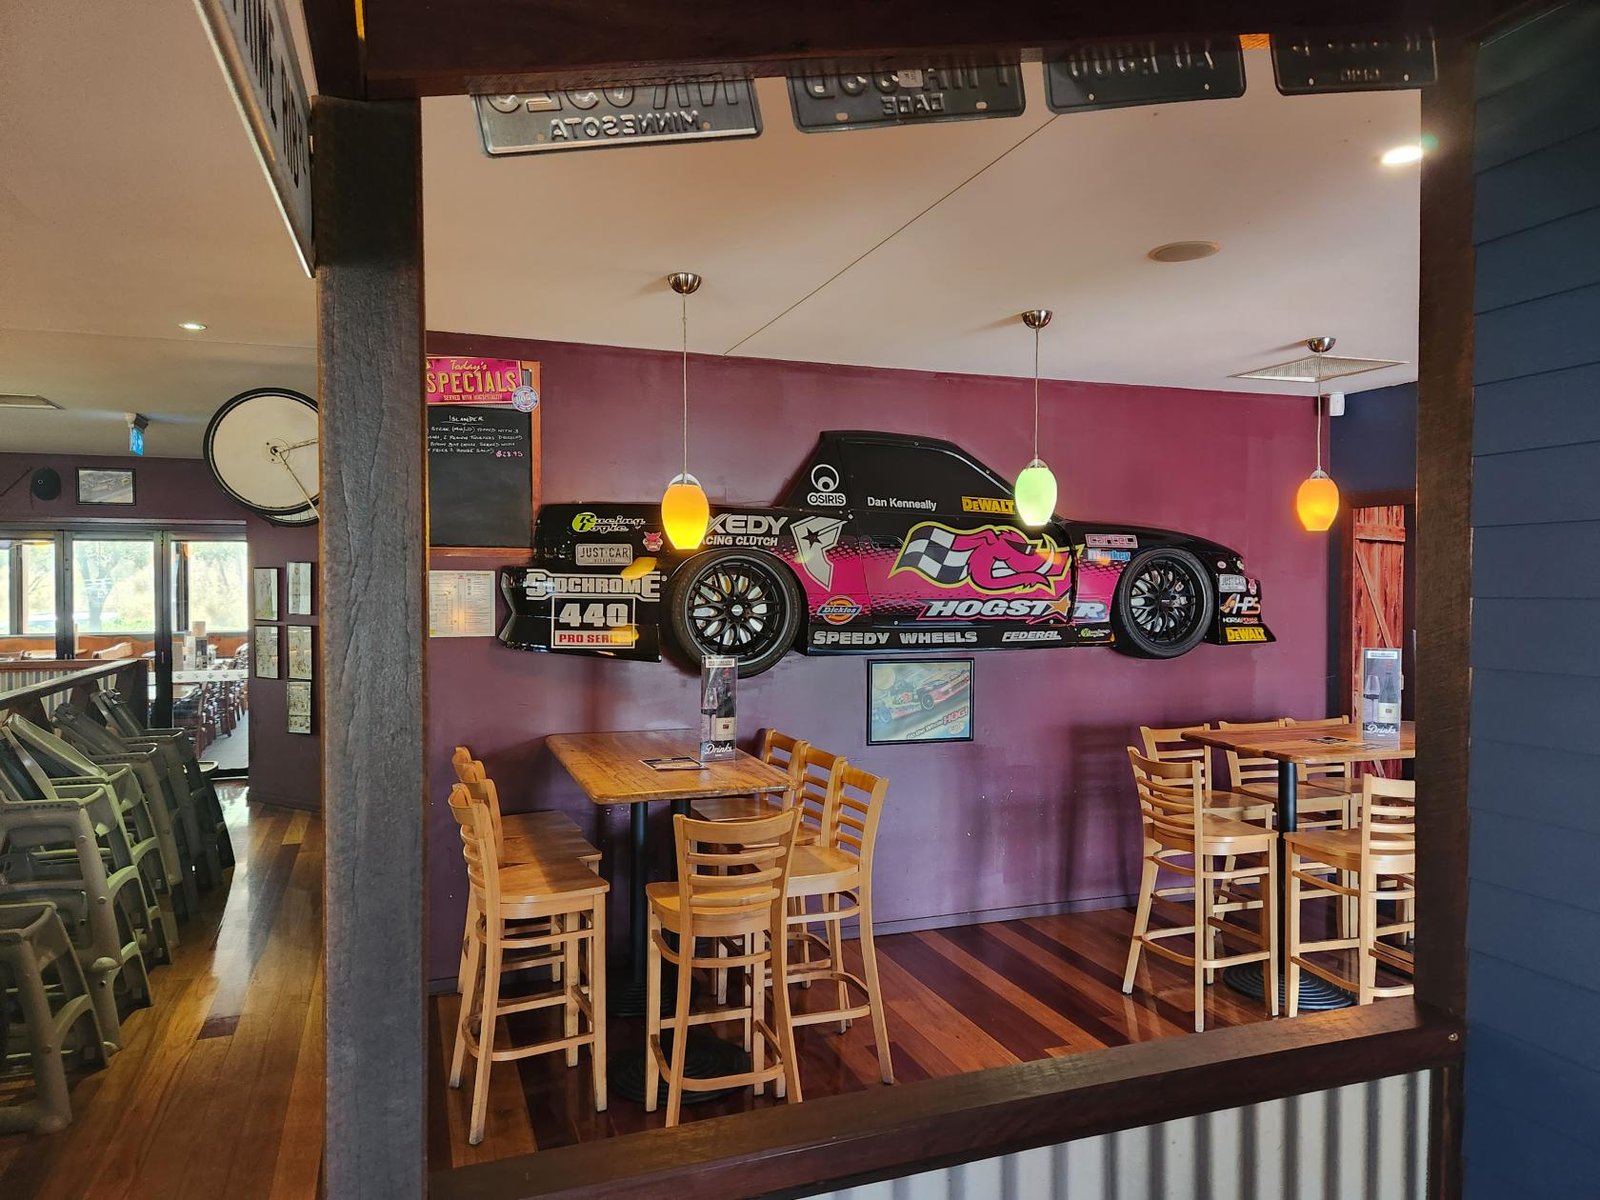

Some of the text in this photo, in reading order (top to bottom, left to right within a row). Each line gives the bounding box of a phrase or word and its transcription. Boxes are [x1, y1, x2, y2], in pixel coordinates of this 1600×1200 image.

[449, 360, 487, 374] Today's
[427, 370, 516, 393] SPECIALS
[807, 493, 846, 506] OSIRIS
[867, 496, 937, 511] Dan Kenneally
[705, 513, 789, 535] XEDY
[735, 535, 779, 547] CLUTCH
[580, 547, 629, 558] JUST CAR
[559, 603, 628, 627] 440
[822, 606, 857, 615] Dickies
[558, 634, 583, 643] PRO
[812, 631, 977, 645] SPEEDY WHEELS
[1001, 630, 1062, 642] FEDERAL
[1366, 724, 1397, 734] Drinks
[704, 742, 733, 755] Drinks
